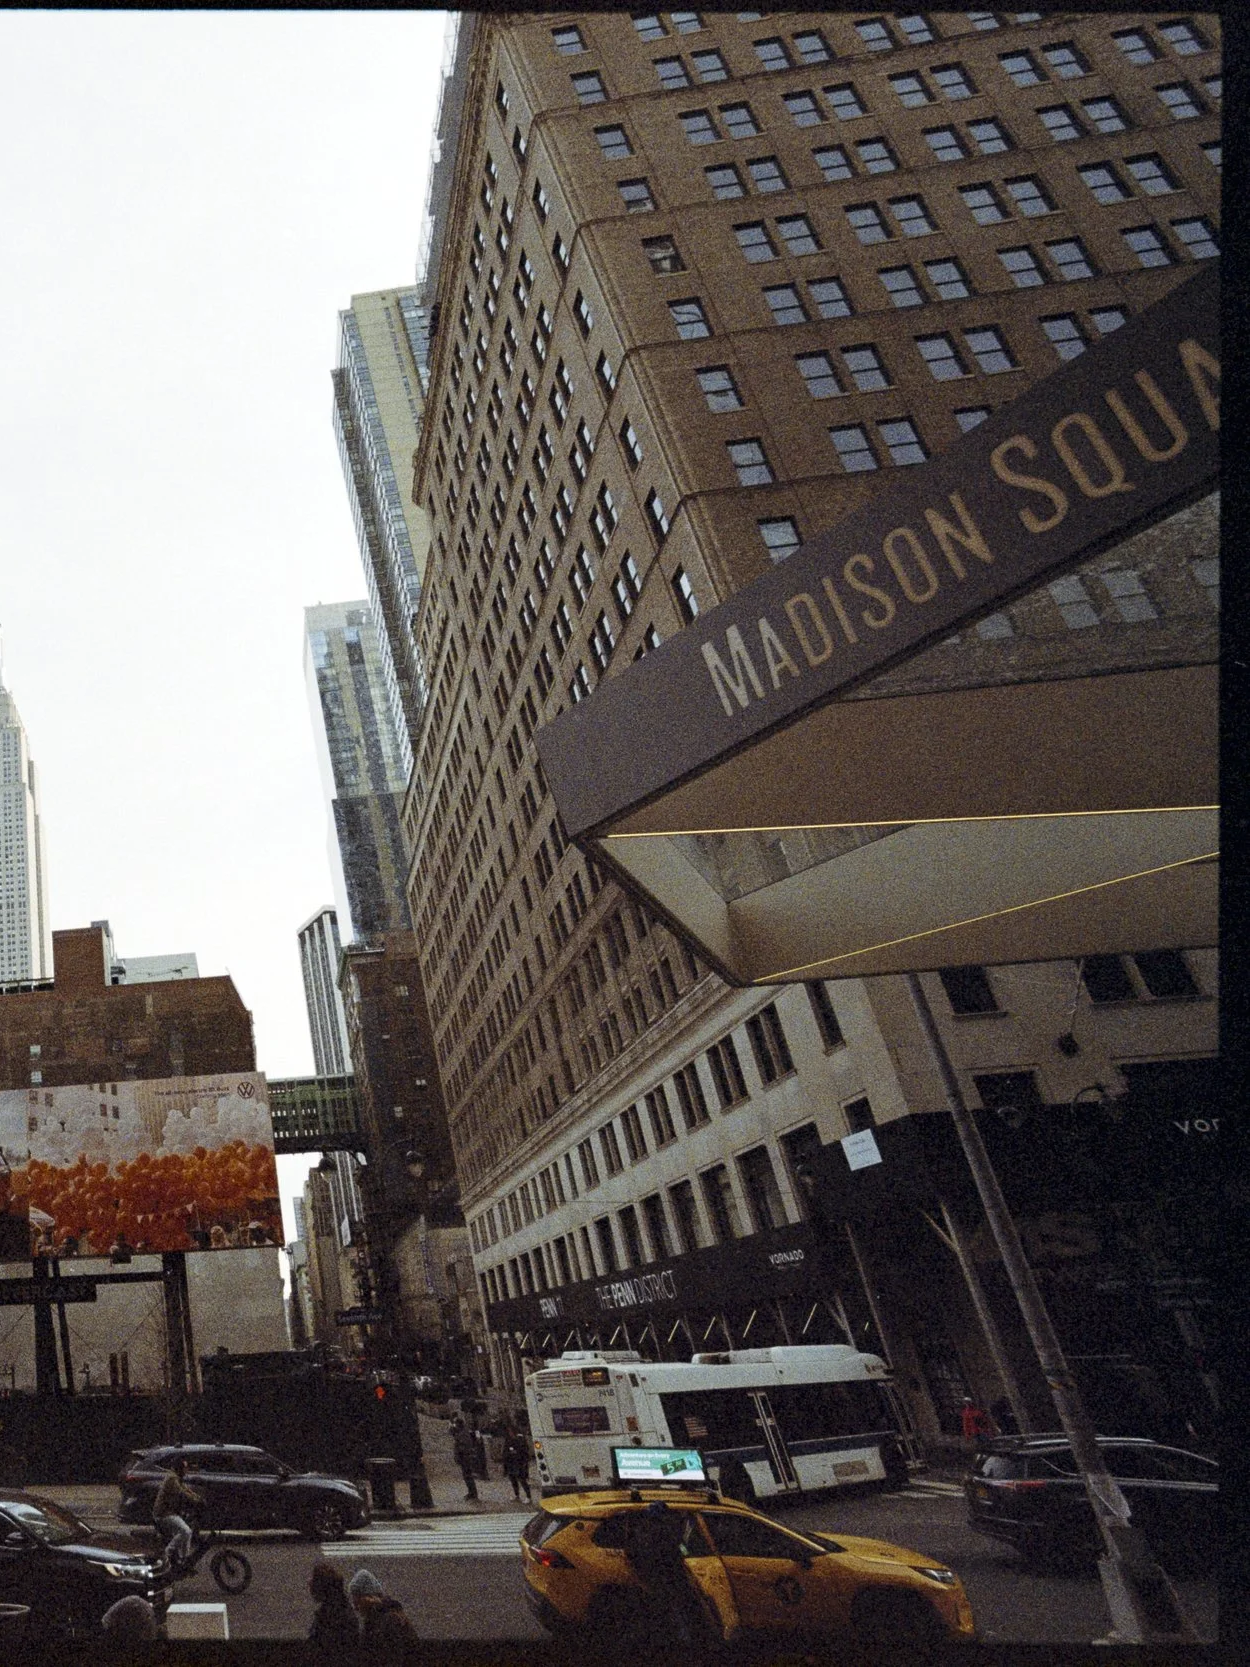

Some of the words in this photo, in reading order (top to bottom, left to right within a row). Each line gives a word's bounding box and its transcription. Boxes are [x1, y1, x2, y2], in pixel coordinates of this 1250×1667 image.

[701, 494, 994, 716] MADISON
[768, 1248, 805, 1265] VORNADO
[594, 1285, 614, 1310] THE
[611, 1279, 638, 1308] PENN
[633, 1269, 678, 1304] DISTRICT
